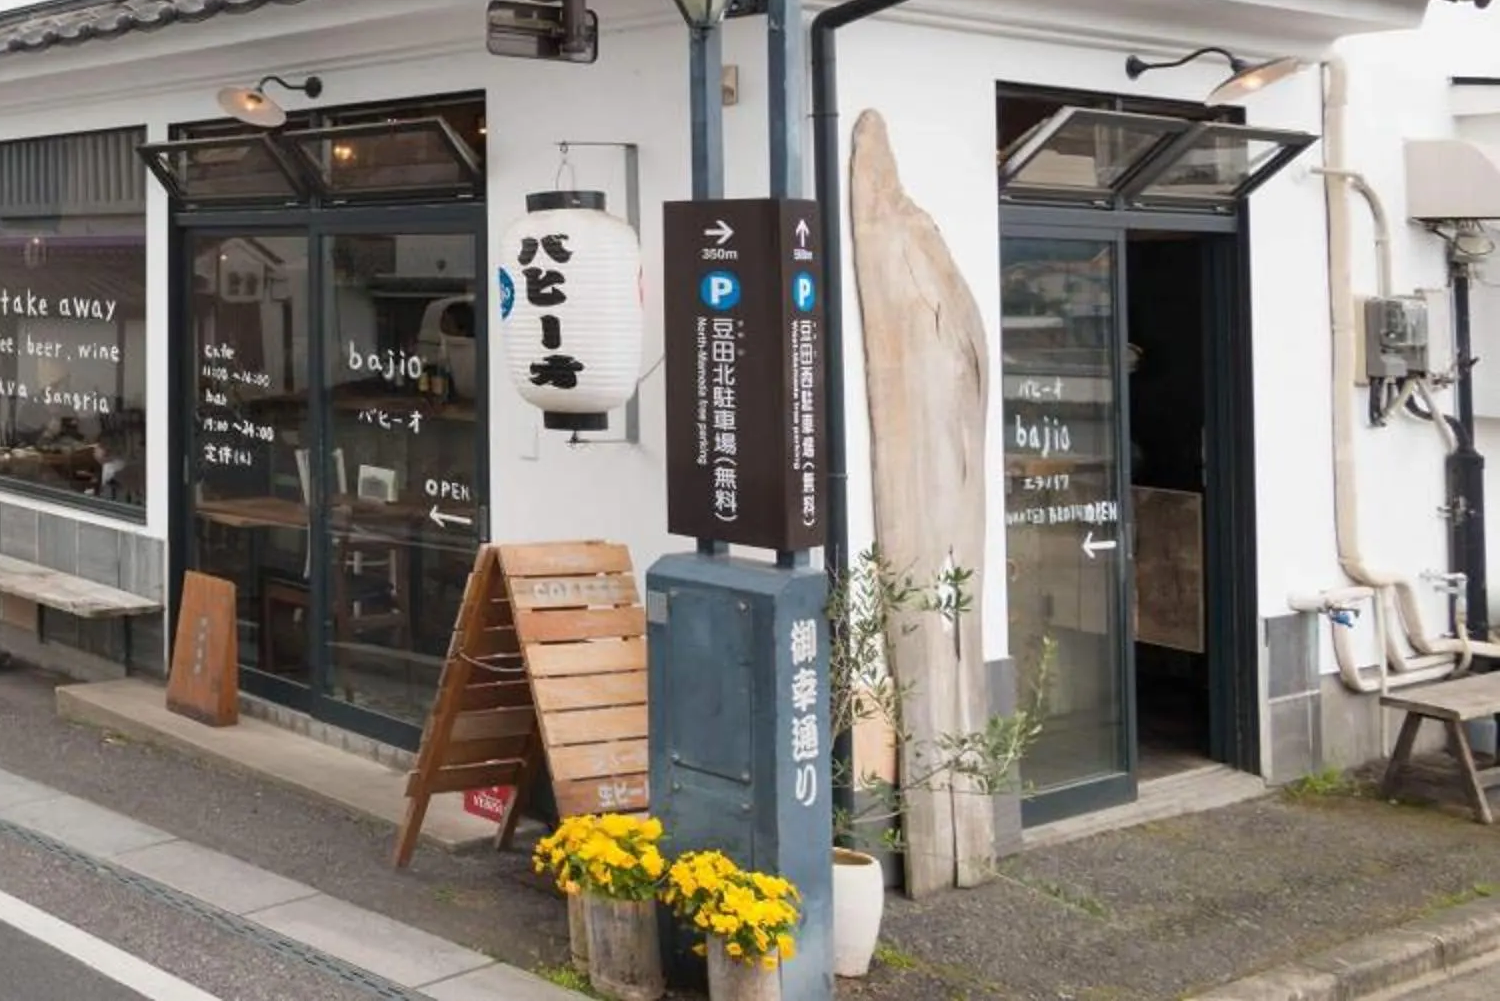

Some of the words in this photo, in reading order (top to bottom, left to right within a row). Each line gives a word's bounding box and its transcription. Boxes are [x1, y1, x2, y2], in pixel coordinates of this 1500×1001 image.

[0, 288, 48, 318] take
[59, 296, 117, 322] away
[710, 276, 733, 305] P
[798, 278, 811, 307] P
[78, 340, 120, 363] wine
[349, 341, 422, 380] bajio
[359, 408, 422, 434] バヒーオ
[1015, 414, 1070, 458] bajio
[425, 478, 470, 500] OPEN
